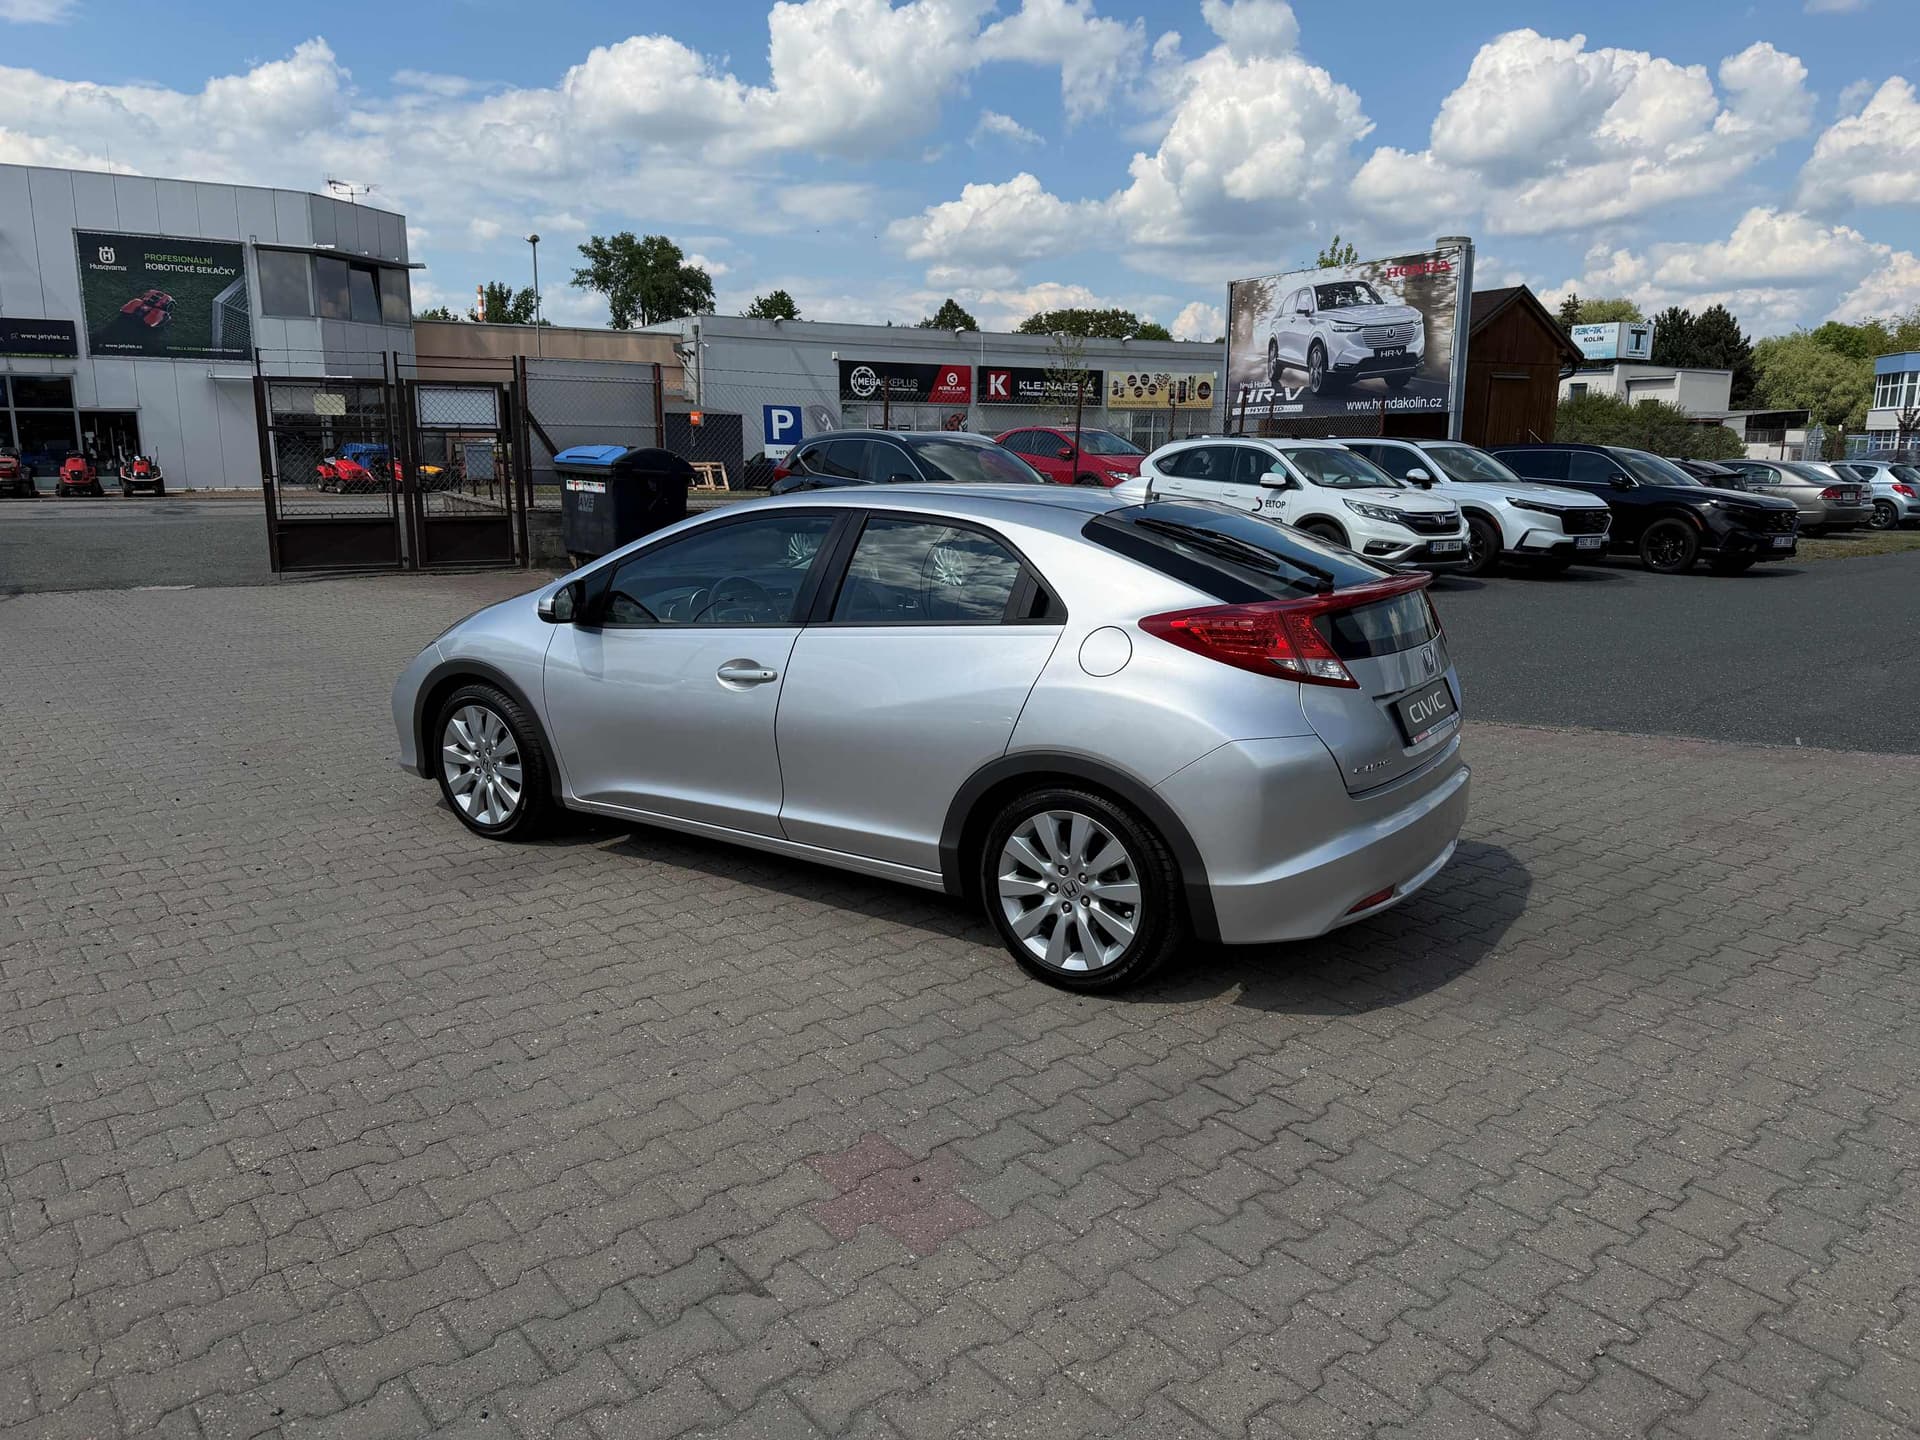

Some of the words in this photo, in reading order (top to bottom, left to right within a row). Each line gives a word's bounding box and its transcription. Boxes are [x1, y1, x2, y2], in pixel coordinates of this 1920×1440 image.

[144, 253, 213, 265] PROFESIONÁLNÍ
[89, 263, 127, 272] Husqvarna
[145, 263, 194, 273] ROBOTICKÉ
[197, 265, 236, 275] SEKAČKY
[1385, 260, 1453, 279] HONDA
[1584, 335, 1604, 343] KOLÍN
[1380, 349, 1404, 358] HR-V
[990, 374, 1008, 396] K
[1019, 380, 1094, 391] KLEJNARSÁ
[1237, 386, 1305, 403] HR-V
[771, 409, 794, 440] P
[1265, 500, 1286, 509] ELTOP
[1409, 690, 1447, 724] CIVIC
